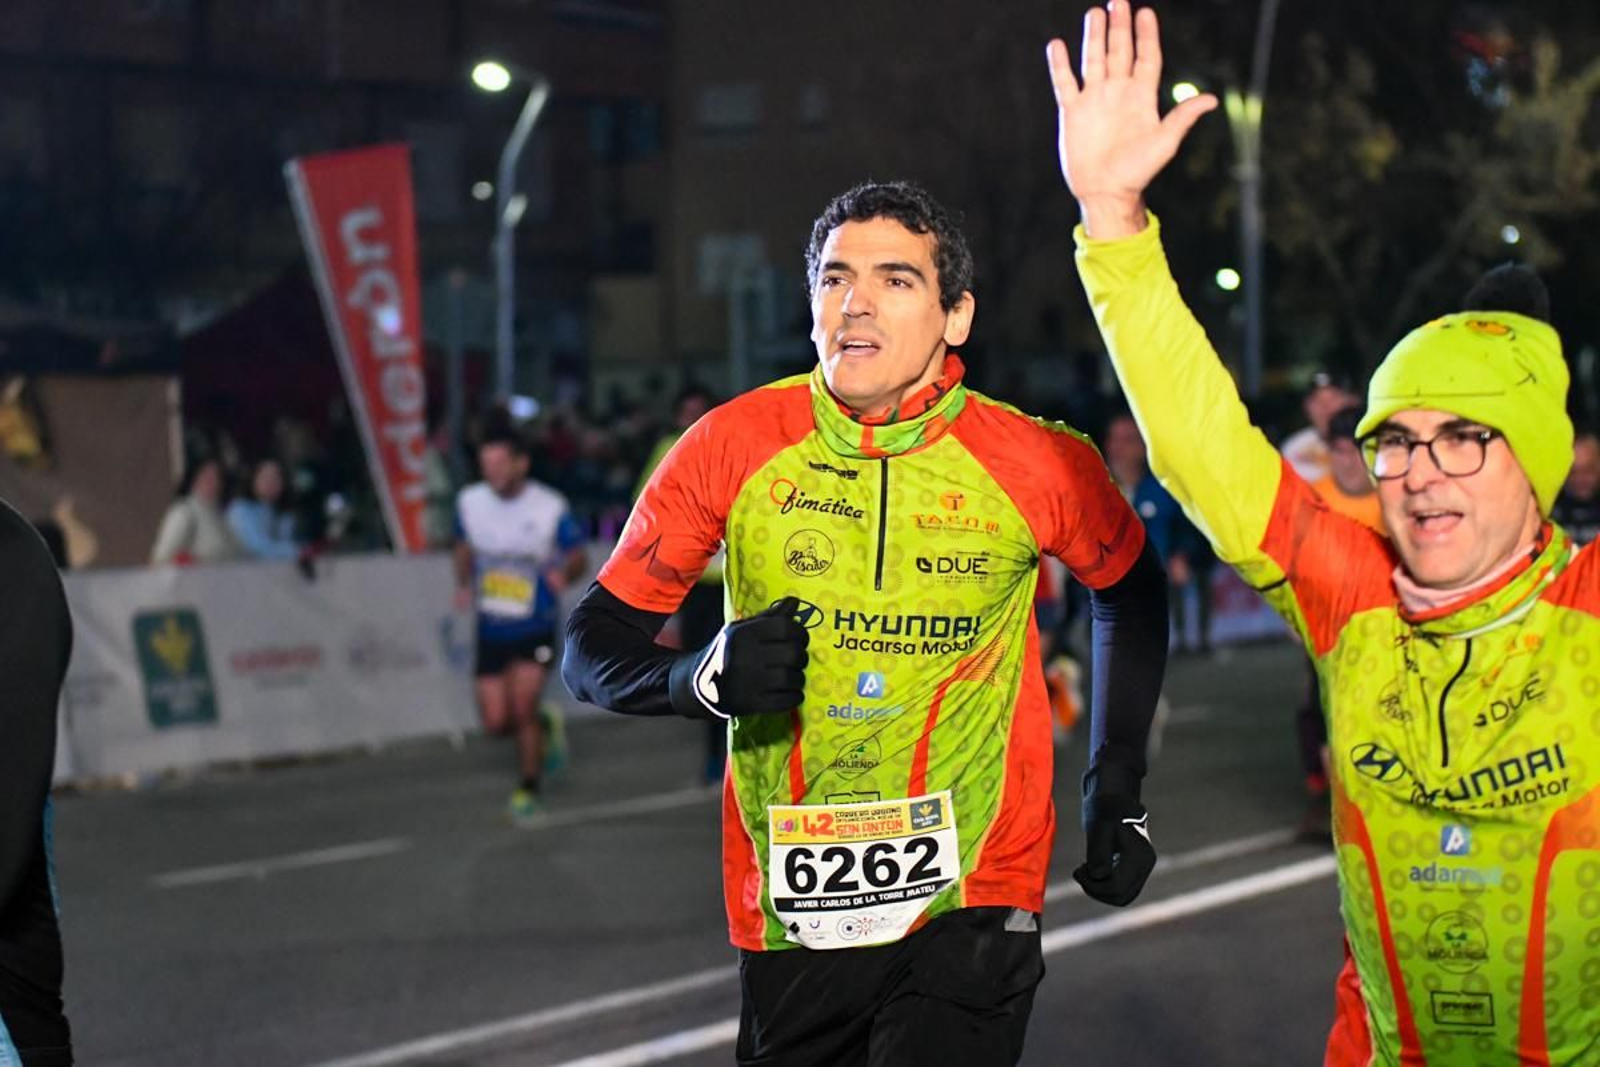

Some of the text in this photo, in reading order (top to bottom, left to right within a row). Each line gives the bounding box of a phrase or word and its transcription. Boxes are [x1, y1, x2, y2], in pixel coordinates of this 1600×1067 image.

[937, 557, 988, 575] DUE
[834, 609, 981, 638] HYUNDAI
[833, 634, 974, 655] Jacarsa Motor
[1490, 677, 1545, 722] DUE
[1413, 744, 1565, 802] UNDAI
[1502, 777, 1568, 808] Motor
[803, 813, 834, 836] 42
[785, 836, 941, 894] 6262
[793, 885, 936, 909] JAVIER CARLOS DE LA TORRE MATEU
